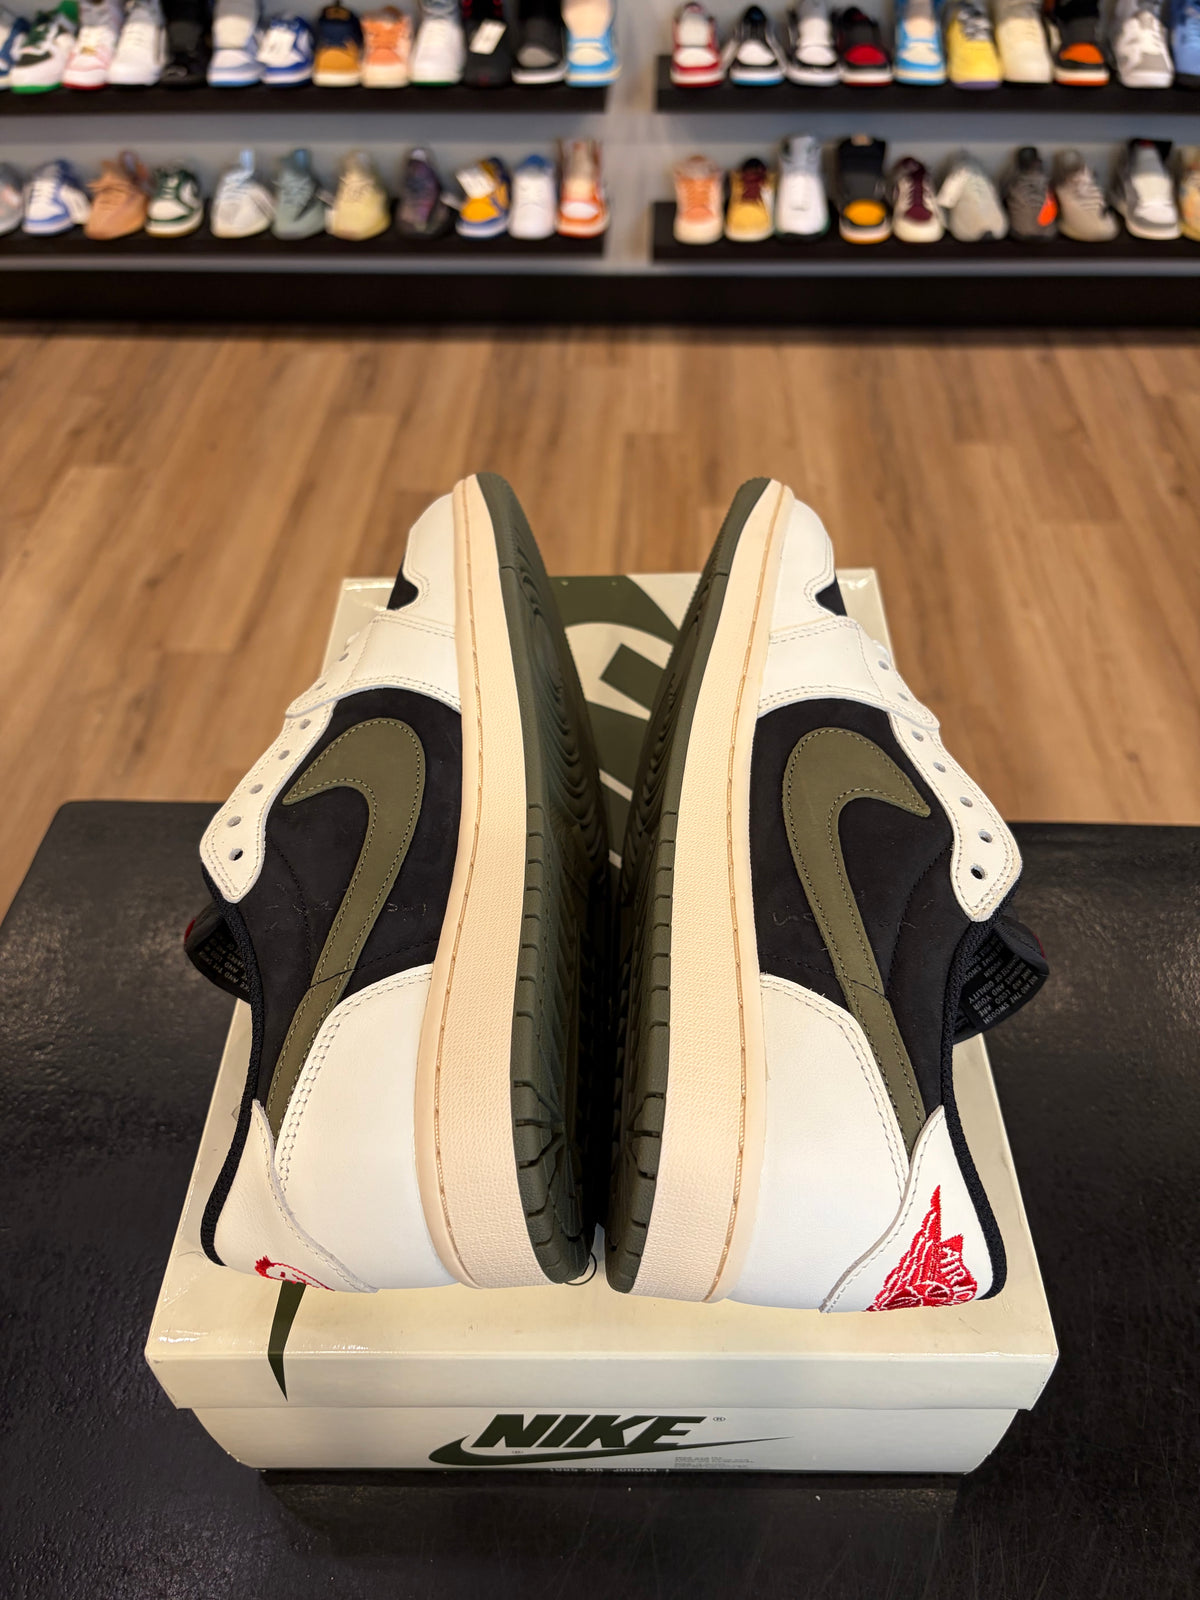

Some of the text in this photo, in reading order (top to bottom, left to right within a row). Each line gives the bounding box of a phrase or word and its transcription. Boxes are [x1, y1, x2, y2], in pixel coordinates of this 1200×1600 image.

[966, 980, 995, 1004] QUALITY
[990, 982, 1006, 997] AND
[1008, 991, 1023, 1004] THE
[972, 993, 992, 1012] YOUR
[977, 1004, 992, 1018] ARE
[982, 1001, 1010, 1025] SWOOSH
[939, 1245, 967, 1285] AIR
[470, 1413, 708, 1449] NIKE
